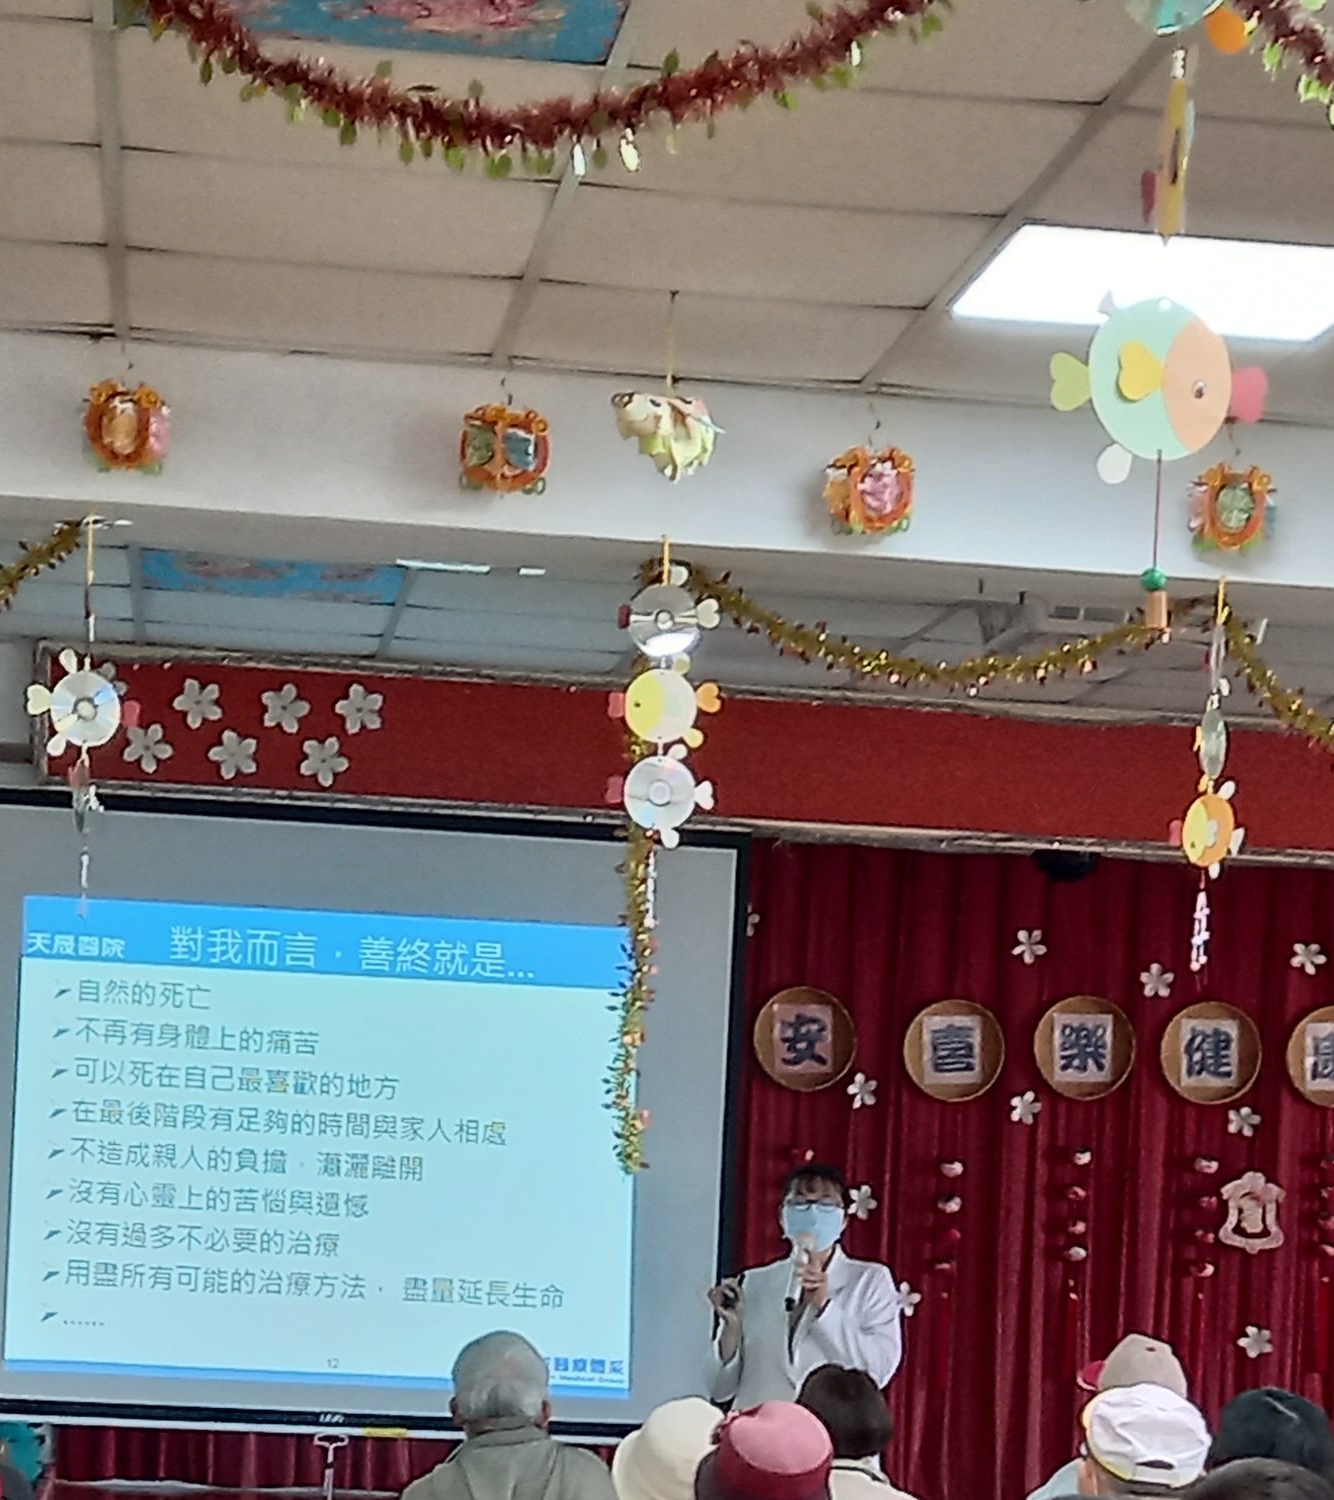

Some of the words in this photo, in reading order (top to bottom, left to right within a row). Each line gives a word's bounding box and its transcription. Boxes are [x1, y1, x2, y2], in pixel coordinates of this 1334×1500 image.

[26, 932, 126, 959] 天晟醫院
[77, 979, 211, 1010] 自然的死亡
[73, 1017, 319, 1056] 不再有身體上的痛苦
[73, 1057, 400, 1100] 可以死在自己最喜歡的地方
[71, 1099, 507, 1146] 在最後階段有足夠的時間與家人相處
[68, 1178, 370, 1218] 沒有心靈上的苦惱與遺憾
[66, 1218, 341, 1258] 沒有過多不必要的治療
